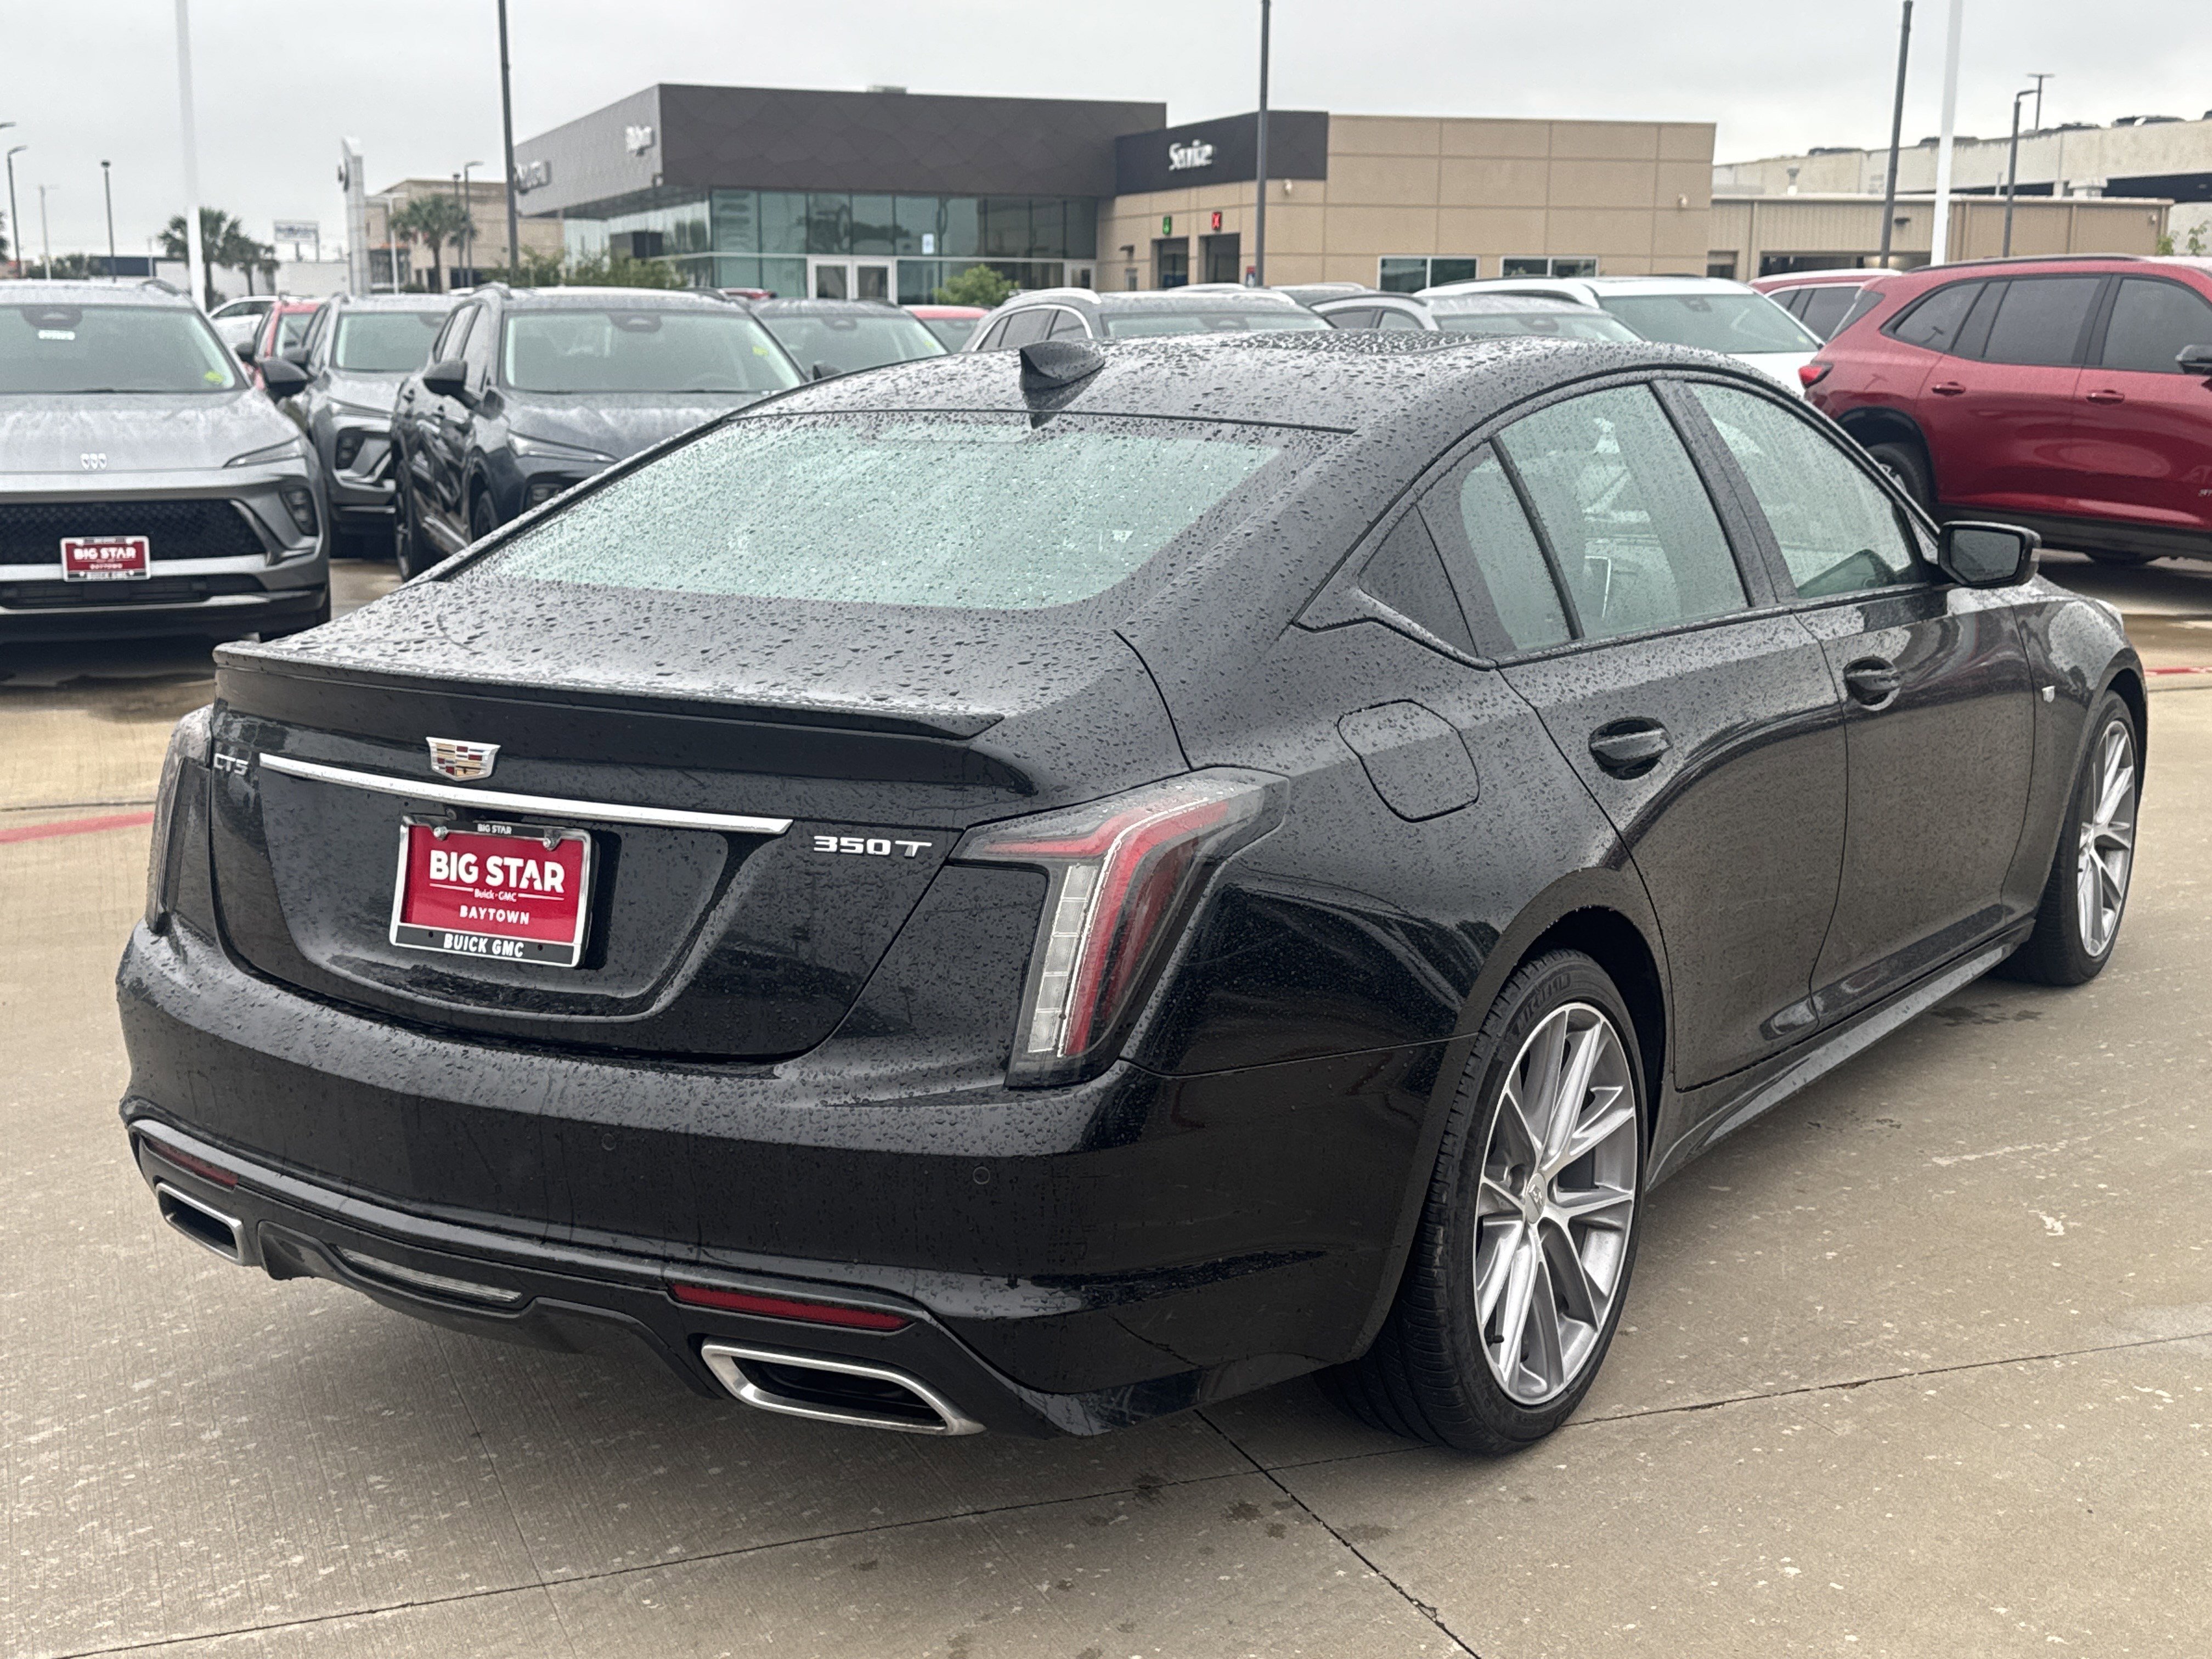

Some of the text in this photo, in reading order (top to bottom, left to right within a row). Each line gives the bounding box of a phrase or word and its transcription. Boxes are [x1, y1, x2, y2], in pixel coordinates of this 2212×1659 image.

[74, 547, 137, 560] BIG STAR
[477, 823, 512, 834] BIG STAR
[814, 836, 932, 857] 350T
[430, 850, 565, 893] BIG STAR
[459, 905, 530, 925] BAYTOWN
[443, 933, 524, 958] BUICK GMC
